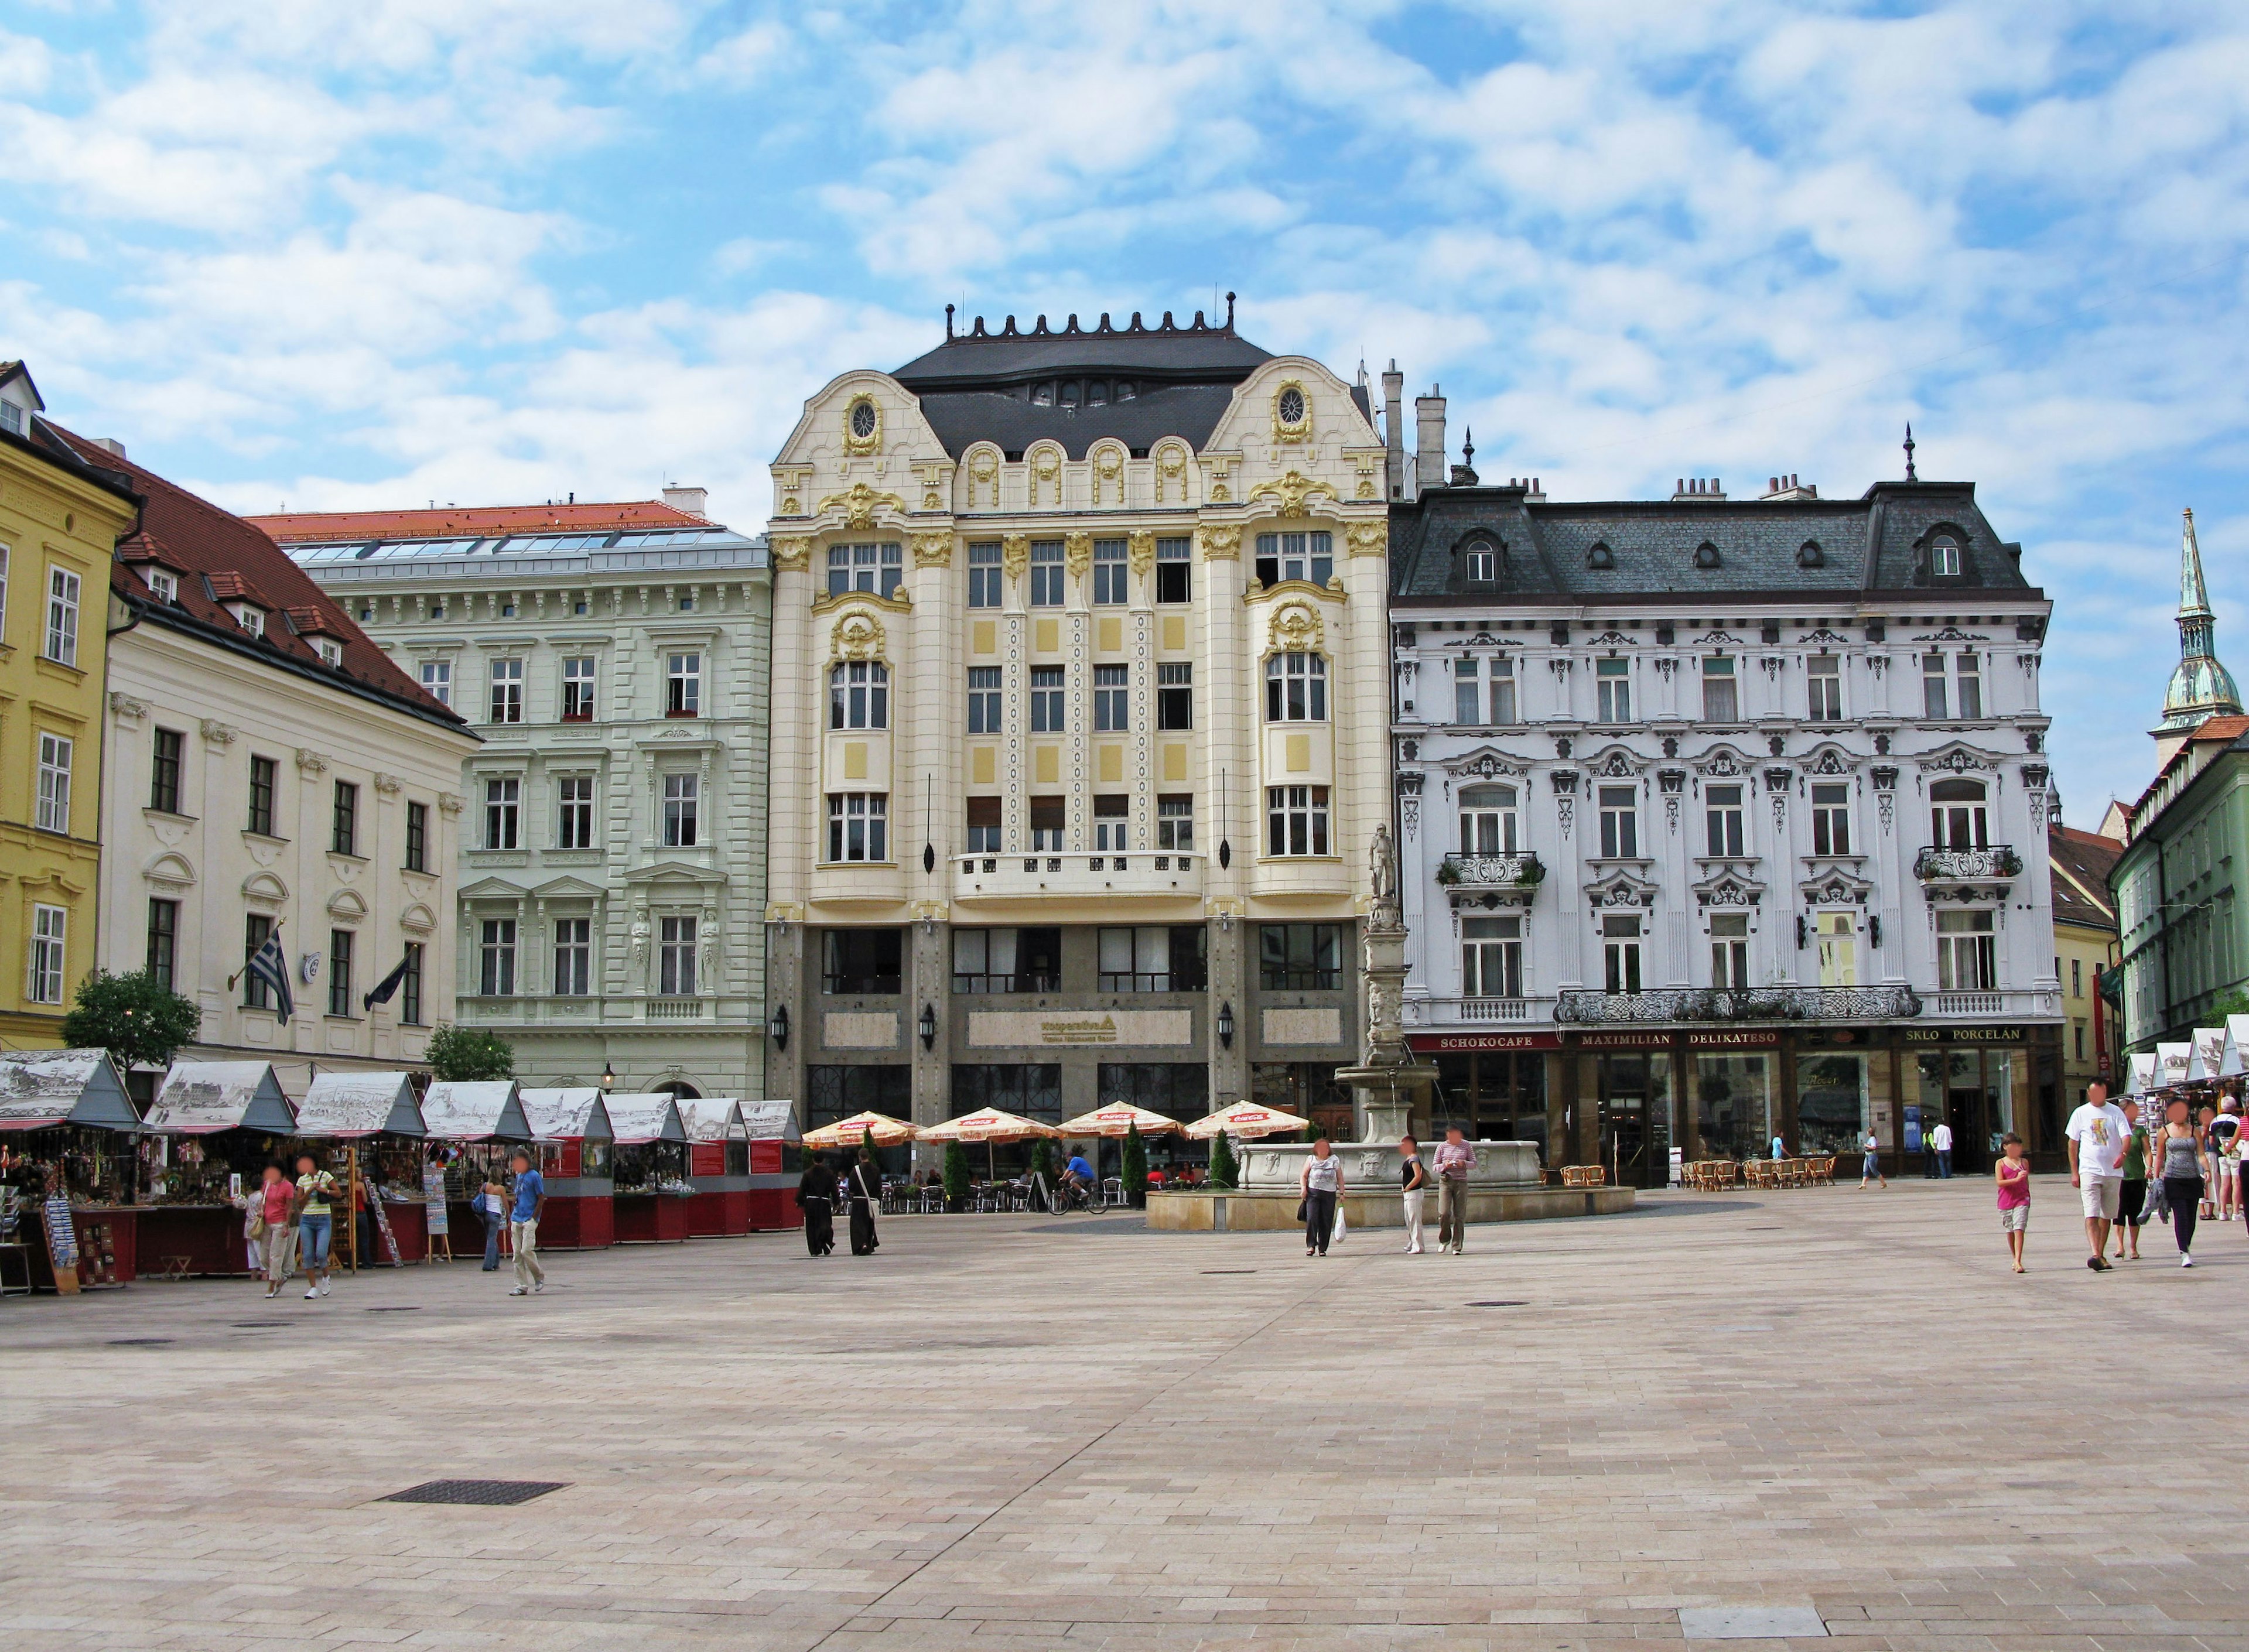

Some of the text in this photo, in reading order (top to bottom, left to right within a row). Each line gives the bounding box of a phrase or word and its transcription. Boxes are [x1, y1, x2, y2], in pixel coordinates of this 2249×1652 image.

[1690, 1033, 1776, 1044] DELIKATESO
[1906, 1027, 2020, 1040] SKLO PORCELÁN
[1441, 1037, 1533, 1048] SCHOKOCAFE
[1582, 1035, 1670, 1045] MAXIMILIAN
[1233, 1114, 1264, 1122] Coca-Cola
